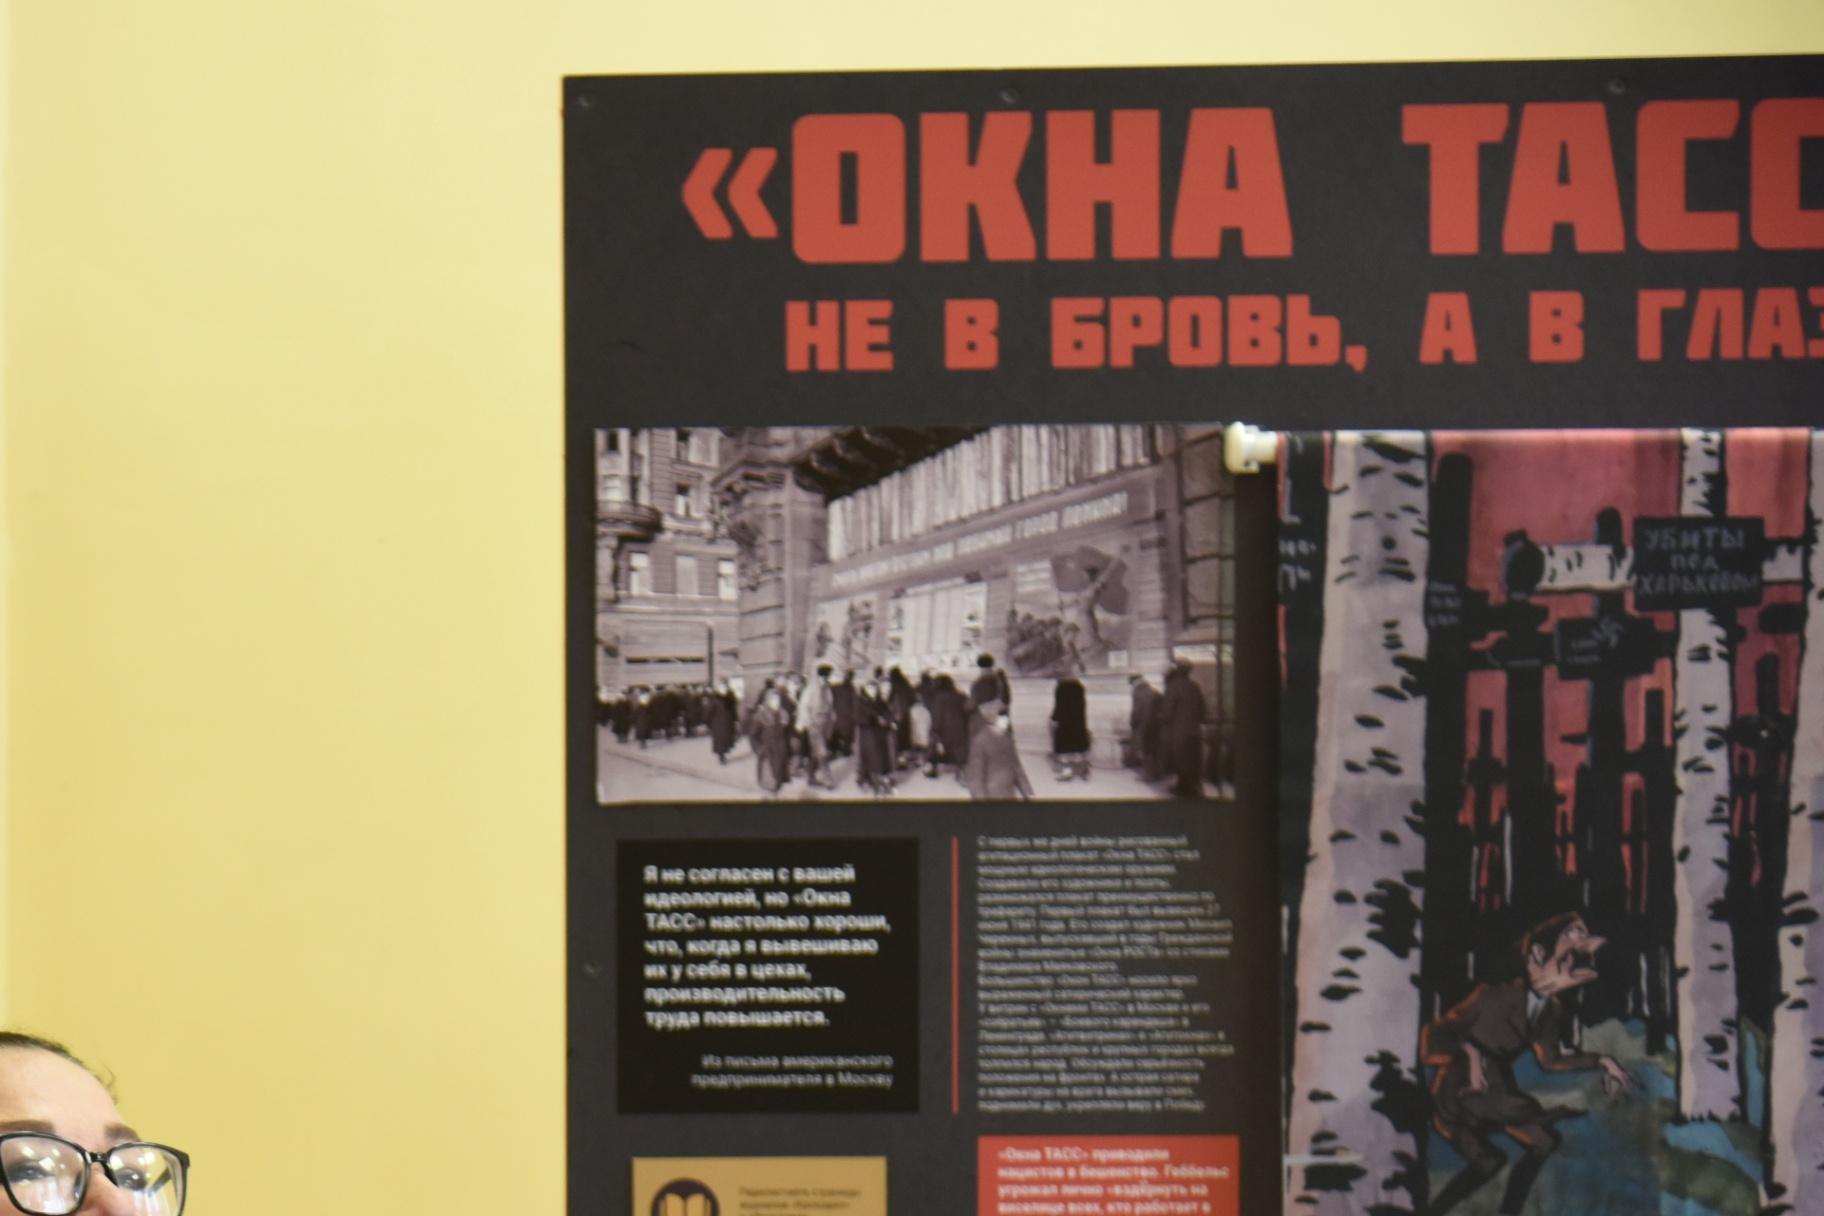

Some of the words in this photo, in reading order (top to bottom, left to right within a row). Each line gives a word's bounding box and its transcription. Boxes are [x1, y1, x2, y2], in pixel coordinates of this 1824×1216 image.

[682, 107, 1293, 264] «ОКНА
[1401, 98, 1824, 255] ТАСС
[785, 300, 894, 372] НЕ
[944, 299, 999, 370] В
[1051, 295, 1367, 373] БРОВЬ,
[1419, 292, 1477, 364] А
[1530, 291, 1584, 363] В
[1646, 527, 1745, 549] УБИТЫ
[644, 865, 657, 881] Я
[661, 868, 685, 881] не
[688, 868, 774, 881] согласен
[777, 868, 789, 881] с
[793, 864, 855, 881] вашей
[644, 889, 760, 909] идеологией,
[764, 893, 789, 906] но
[793, 889, 851, 906] «Окна
[645, 913, 705, 930] ТАСС»
[709, 916, 809, 930] настолько
[814, 916, 890, 933] хороши,
[644, 941, 683, 956] что,
[687, 941, 740, 956] когда
[744, 941, 756, 954] я
[760, 940, 878, 954] вывешиваю
[644, 965, 667, 978] их
[671, 965, 682, 981] у
[686, 960, 731, 978] себя
[735, 965, 746, 978] в
[751, 964, 811, 981] цехах,
[644, 988, 845, 1005] производительность
[645, 1012, 700, 1029] труда
[704, 1011, 829, 1025] повышается.
[702, 1055, 722, 1067] Из
[726, 1057, 778, 1067] письма
[782, 1056, 893, 1069] американского
[692, 1074, 821, 1088] предпринимателя
[839, 1072, 892, 1088] Москву
